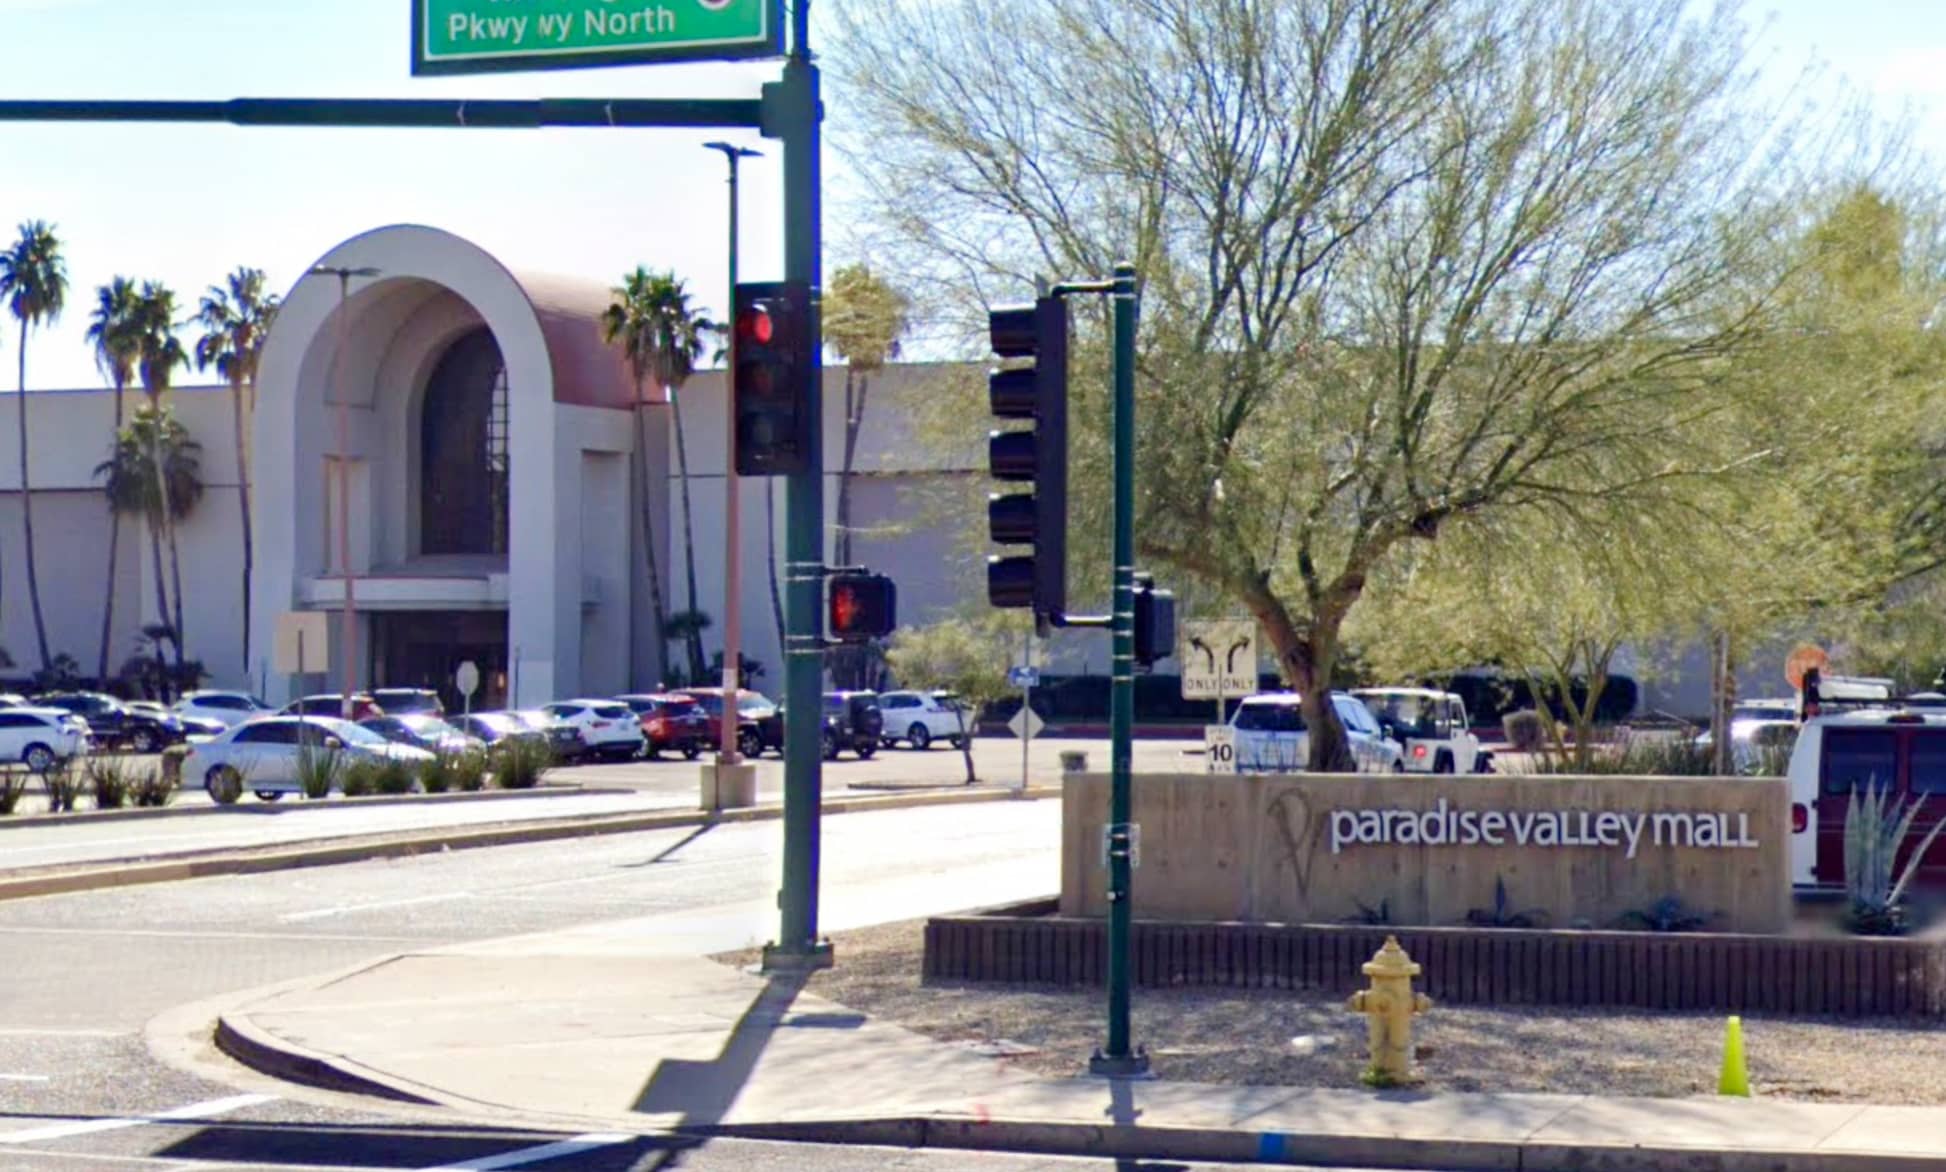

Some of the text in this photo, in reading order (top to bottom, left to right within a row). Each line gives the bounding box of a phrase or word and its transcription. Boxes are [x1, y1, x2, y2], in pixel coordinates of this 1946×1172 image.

[449, 12, 528, 44] Pkwy
[584, 5, 675, 36] North
[1187, 678, 1218, 690] ONLY
[1223, 678, 1254, 690] ONLY
[1208, 743, 1233, 762] 10
[1331, 798, 1507, 854] paradise
